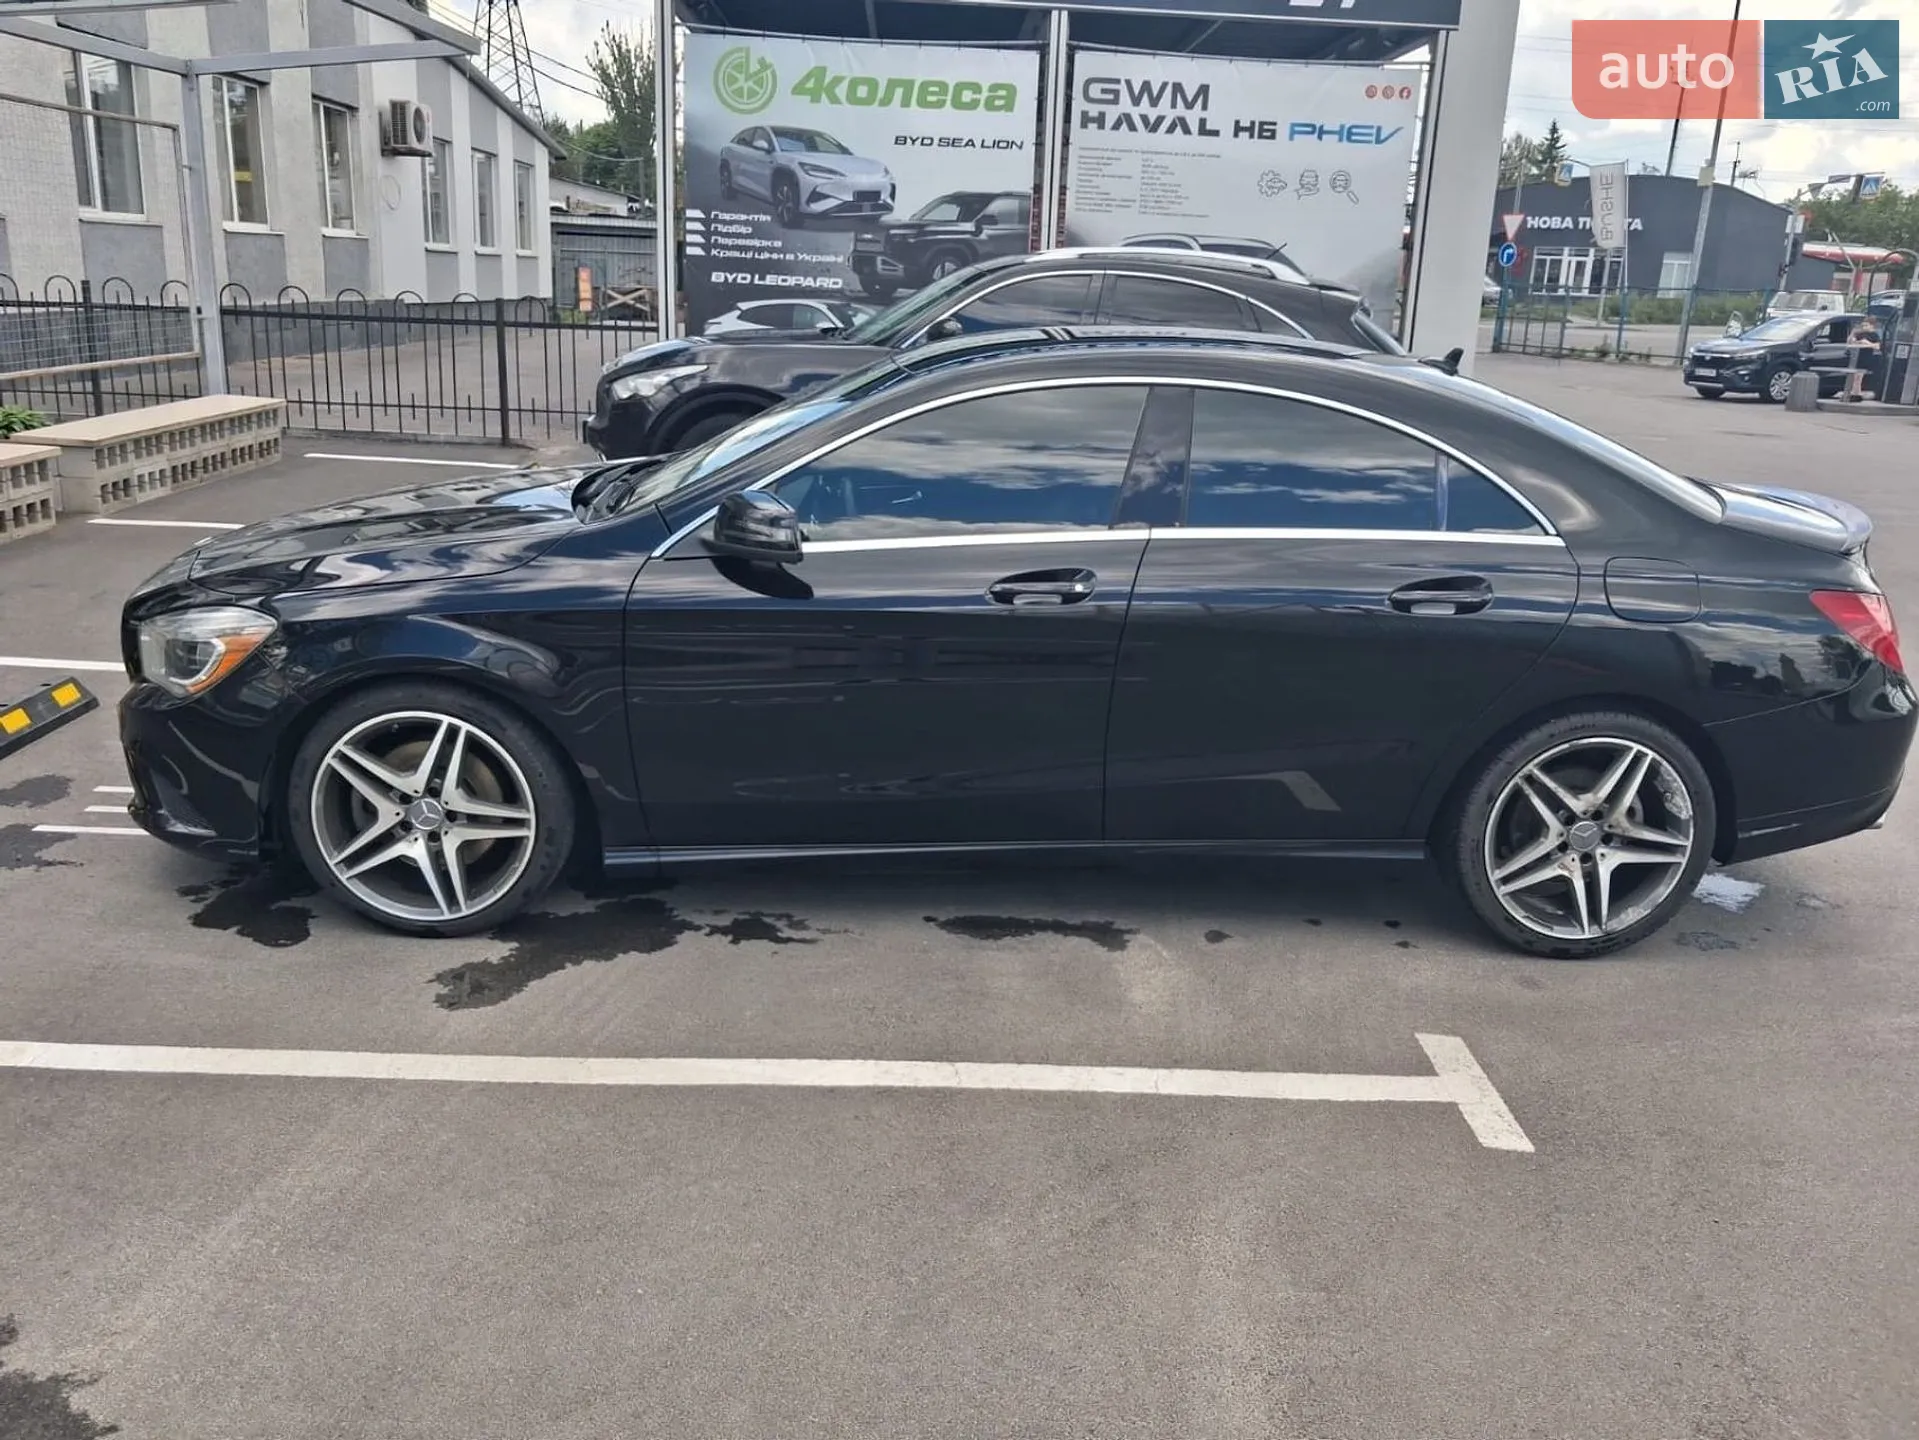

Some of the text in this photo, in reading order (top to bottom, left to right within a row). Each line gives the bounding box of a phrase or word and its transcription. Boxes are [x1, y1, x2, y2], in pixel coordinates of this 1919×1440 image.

[790, 65, 1018, 113] 4колеса
[1082, 77, 1211, 112] GWM
[1079, 109, 1405, 145] HAVAL H6 PHEV
[894, 135, 1024, 151] BYD SEA LION
[1526, 215, 1574, 229] НОВА
[711, 271, 844, 289] BYD LEOPARD
